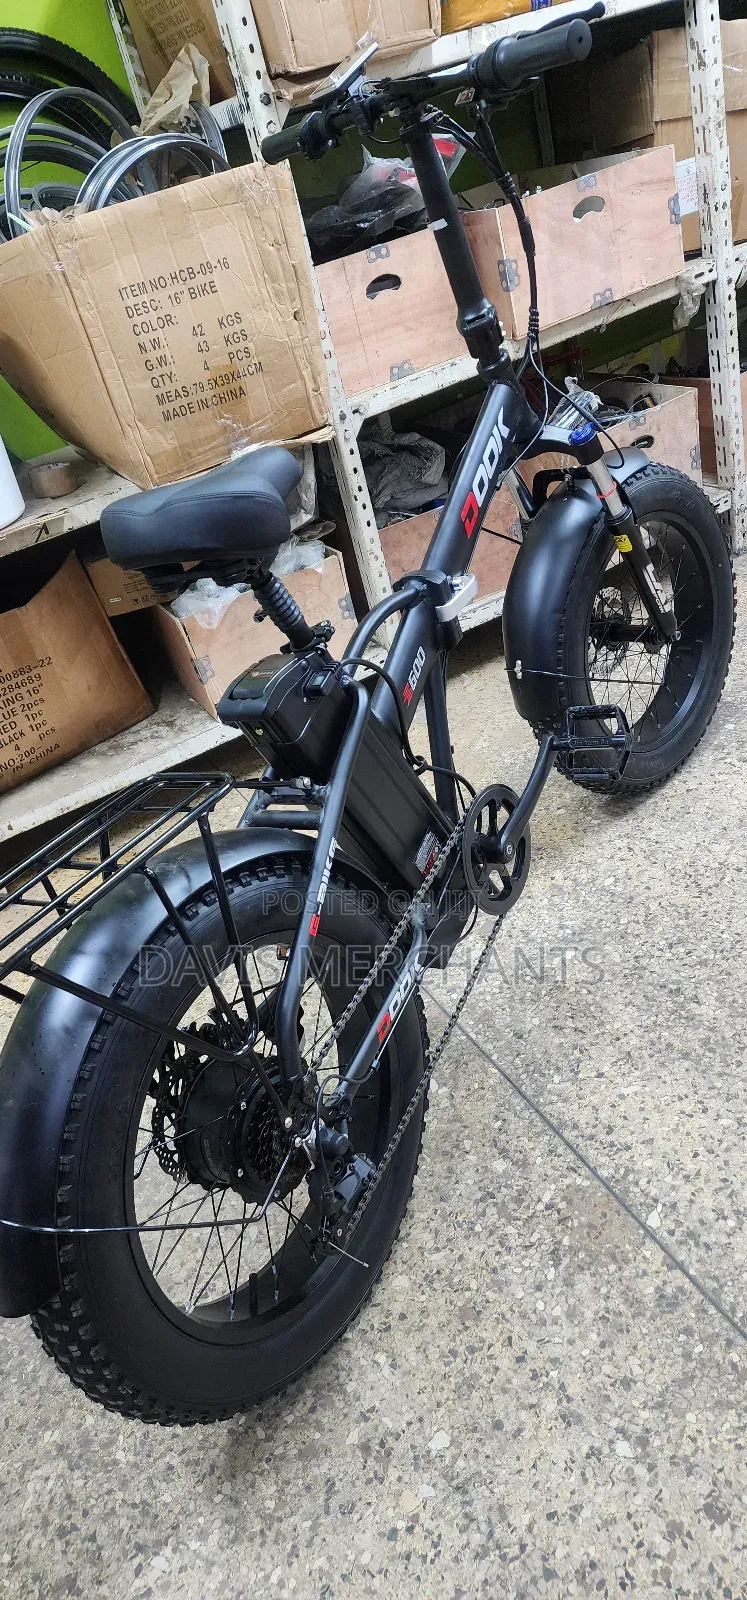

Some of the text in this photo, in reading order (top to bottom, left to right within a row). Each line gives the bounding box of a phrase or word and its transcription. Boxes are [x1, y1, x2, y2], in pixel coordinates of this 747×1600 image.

[118, 257, 230, 301] ITEM NO:HCB-09-16
[125, 299, 163, 319] DESC:
[188, 280, 218, 300] BIKE
[132, 314, 179, 336] COLOR:
[138, 311, 242, 354] N.W.: 42 KGS
[144, 329, 248, 371] G.W.: 43 KGS
[150, 346, 251, 389] QTY: 4 PCS
[161, 385, 247, 423] MADE IN CHINA
[0, 672, 42, 698] 284689
[0, 692, 24, 710] ING
[20, 697, 45, 713] 2pcs
[24, 709, 44, 722] 1pc
[29, 719, 48, 732] 1pc
[14, 726, 56, 752] 4 pcs
[12, 742, 61, 773] IN CHINA
